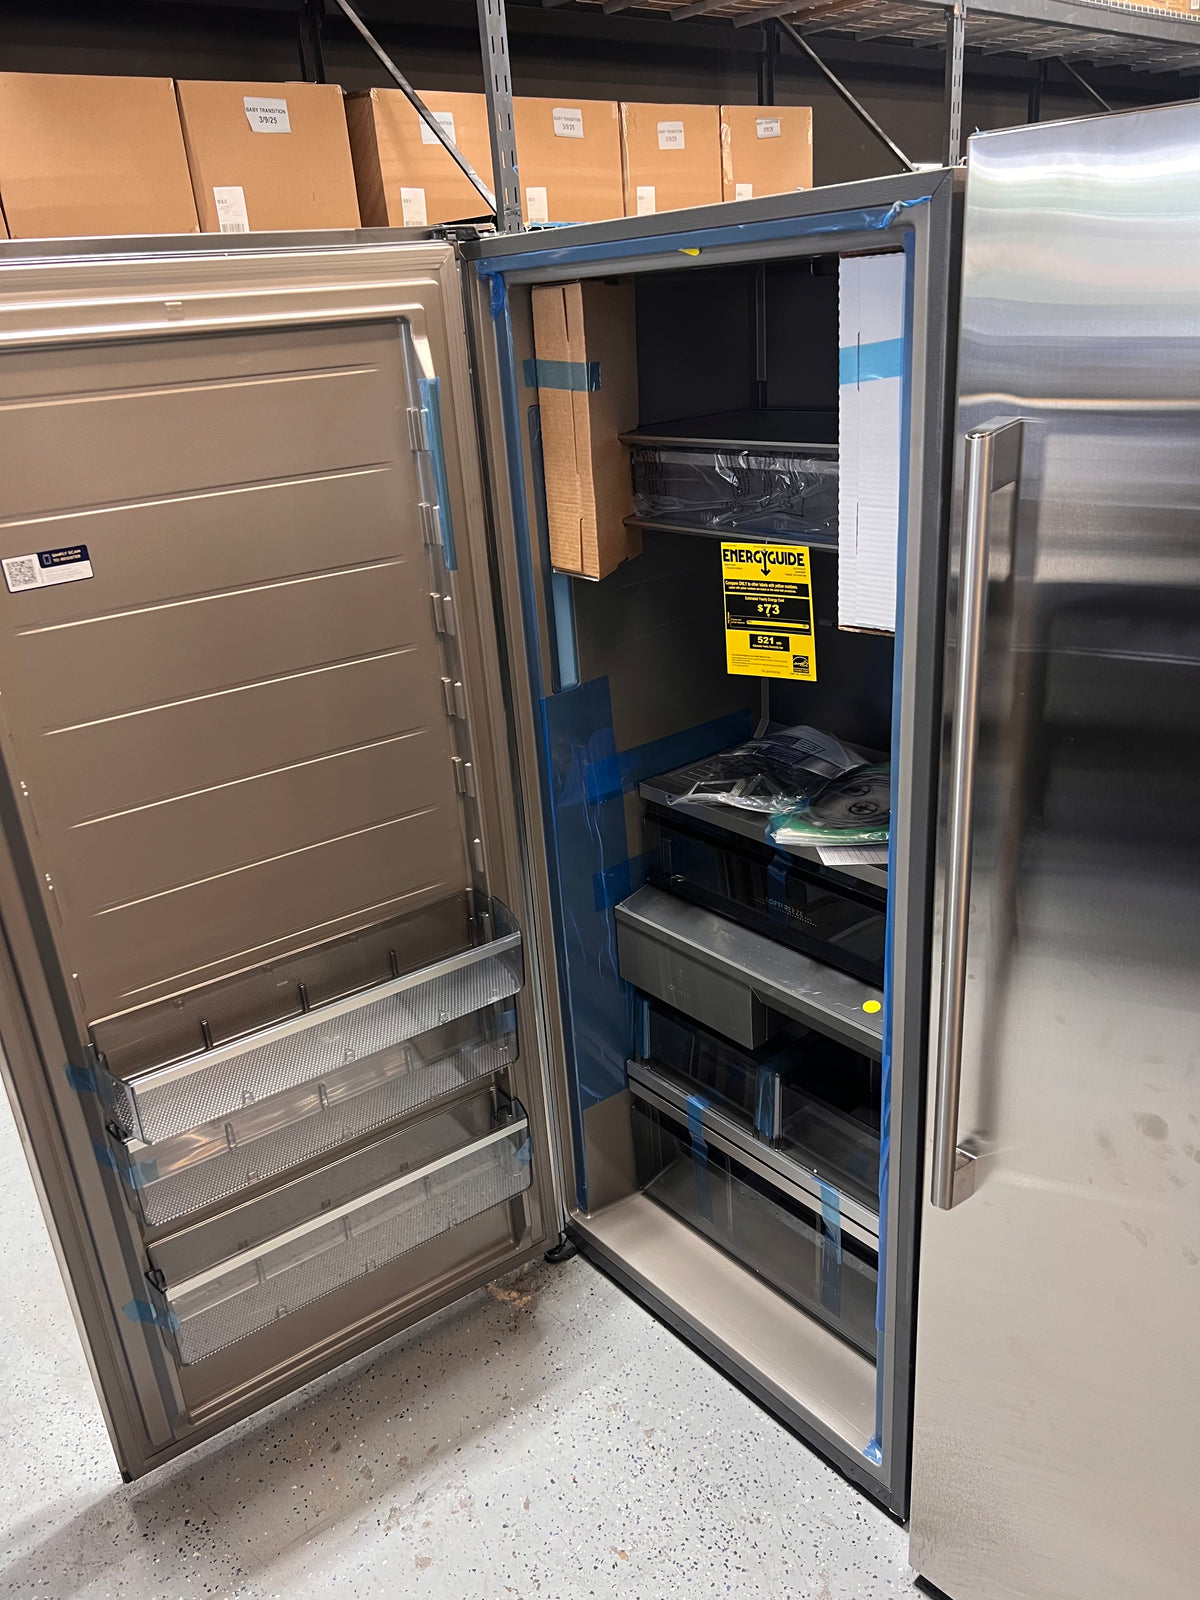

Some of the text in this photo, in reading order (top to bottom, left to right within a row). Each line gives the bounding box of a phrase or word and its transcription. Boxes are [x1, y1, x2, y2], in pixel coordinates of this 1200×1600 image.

[259, 116, 278, 124] 3/9/25
[722, 548, 805, 567] ENERGYGUIDE
[757, 604, 780, 615] $73
[757, 635, 774, 645] 521
